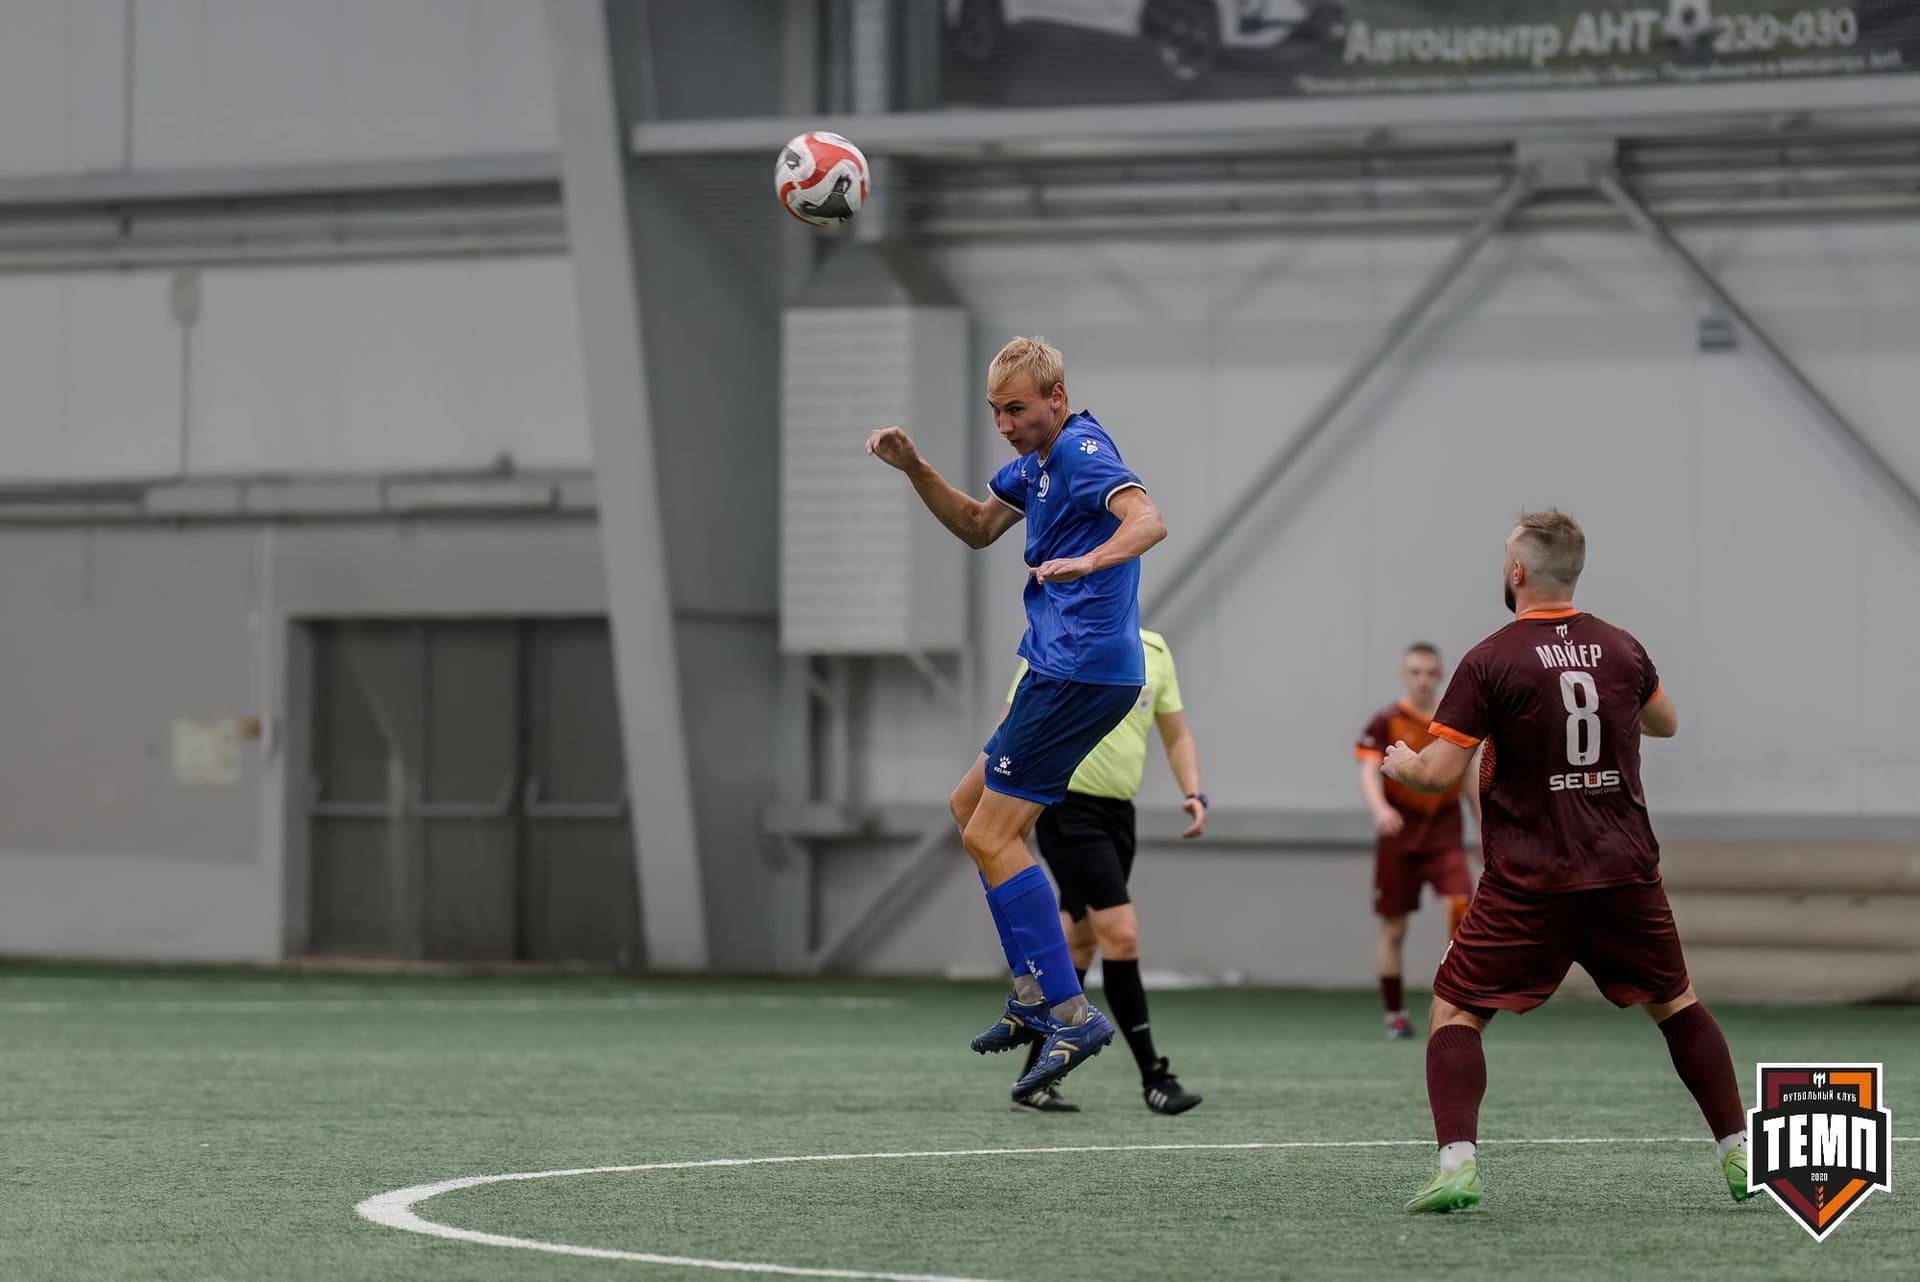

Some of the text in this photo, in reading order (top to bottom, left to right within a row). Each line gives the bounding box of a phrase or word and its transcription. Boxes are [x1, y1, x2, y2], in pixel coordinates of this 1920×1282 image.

[1535, 640, 1602, 669] МАЙЕР
[1559, 670, 1601, 766] 8
[1549, 770, 1620, 791] SEUS
